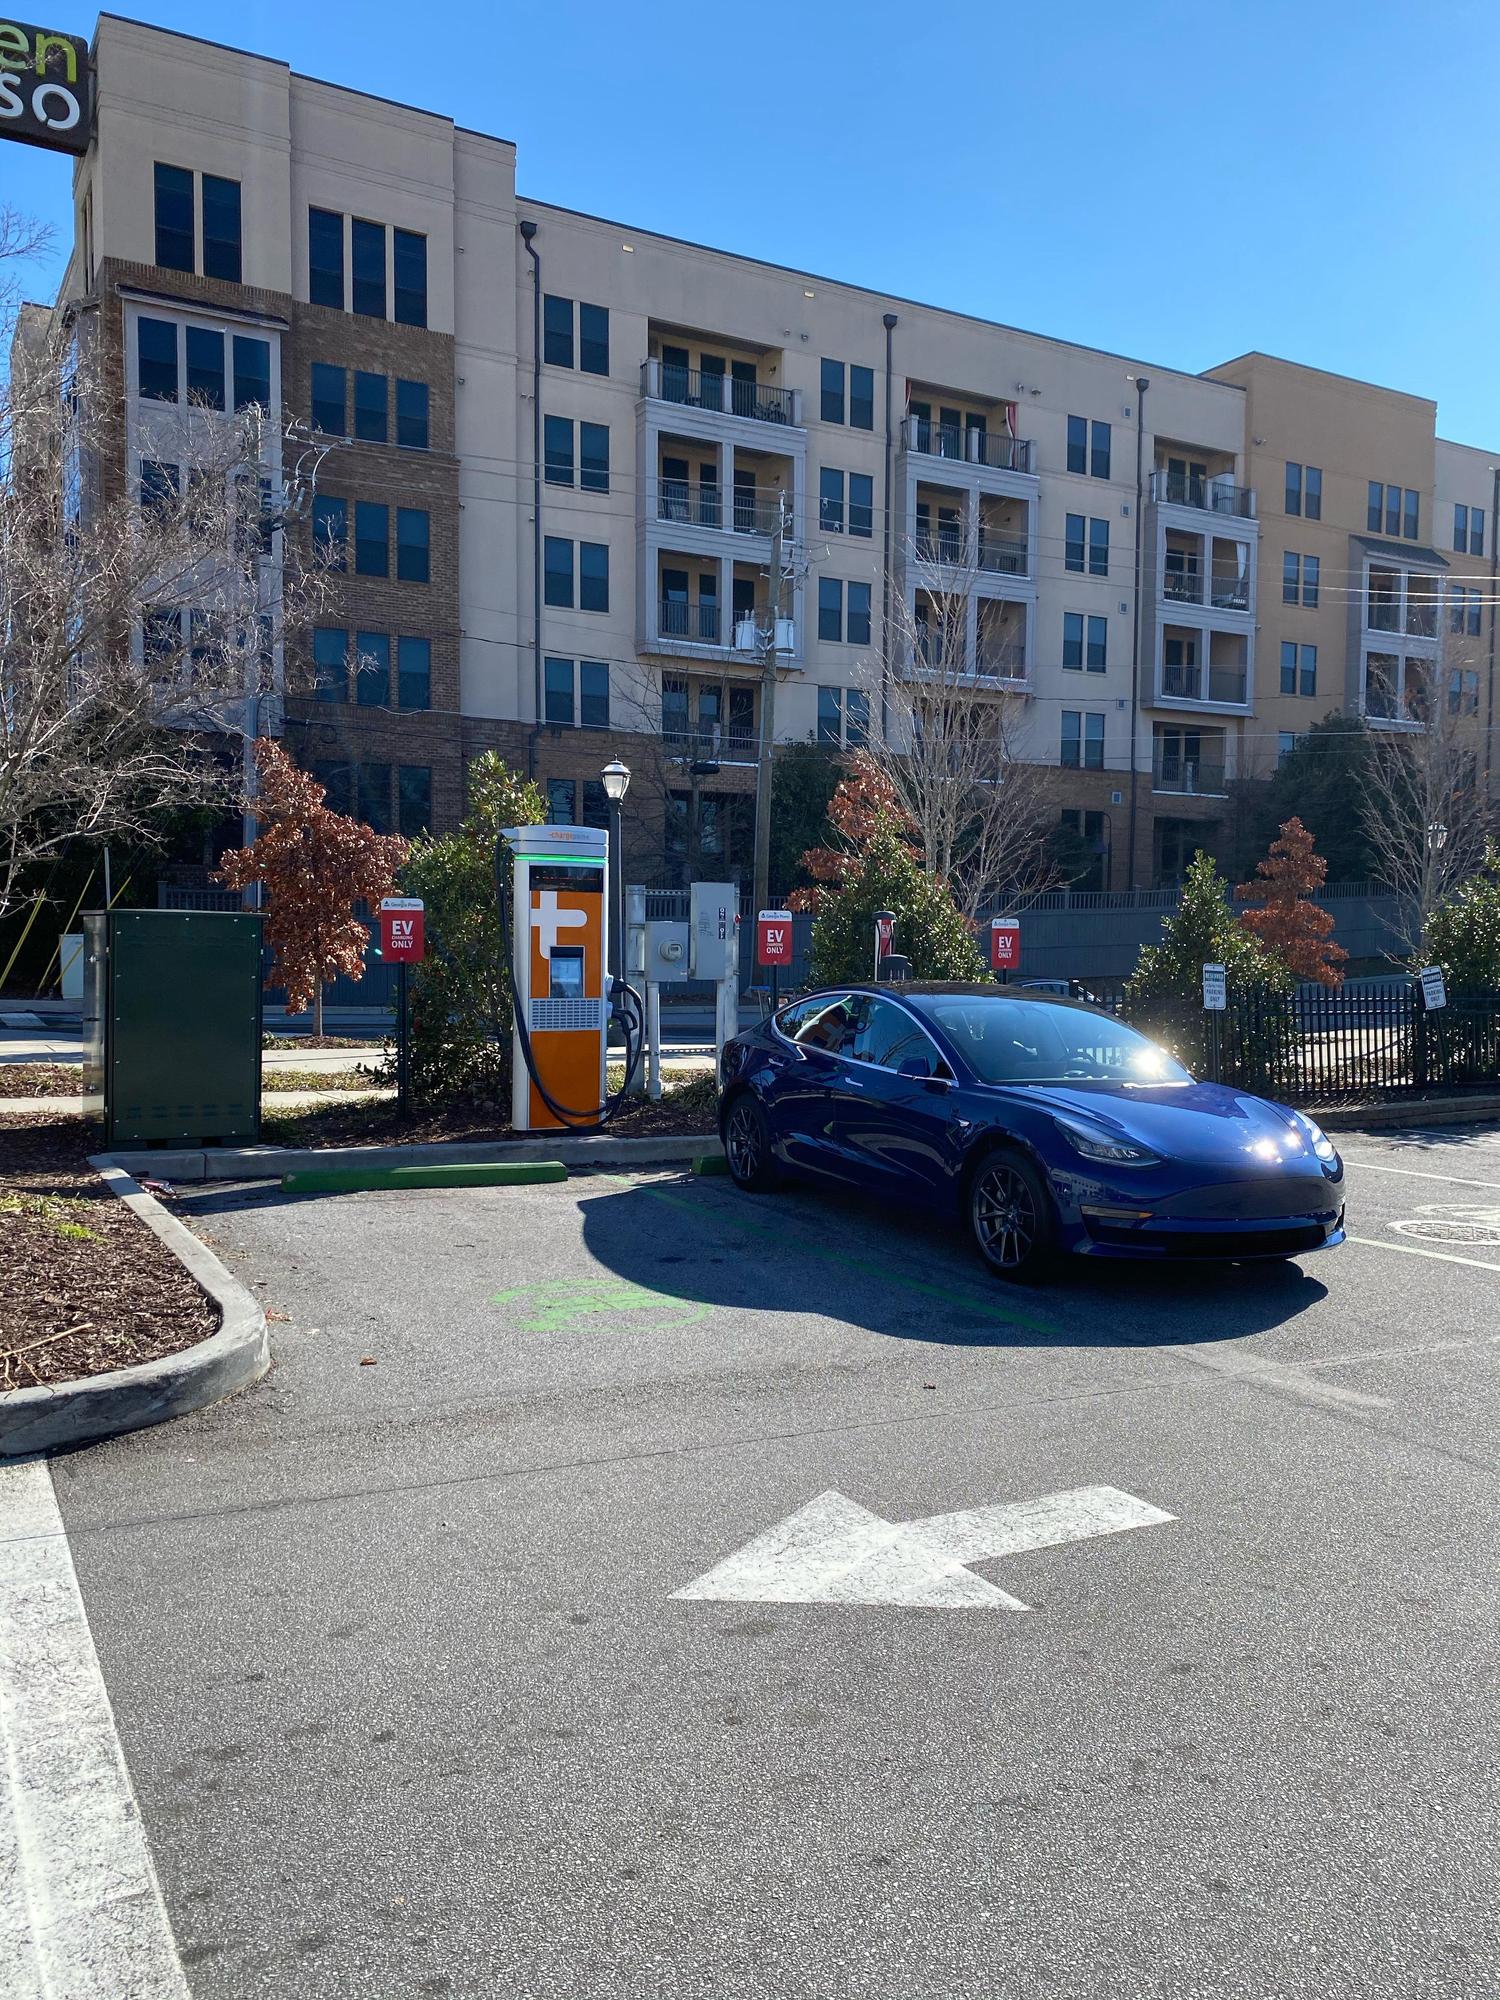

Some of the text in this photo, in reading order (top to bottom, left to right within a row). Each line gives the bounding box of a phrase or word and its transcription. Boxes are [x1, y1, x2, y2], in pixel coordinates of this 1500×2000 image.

[0, 24, 77, 82] en
[392, 920, 413, 935] EV
[767, 929, 784, 943] EV
[998, 936, 1012, 948] EV
[391, 940, 413, 949] ONLY
[766, 946, 784, 954] ONLY
[997, 951, 1012, 959] ONLY
